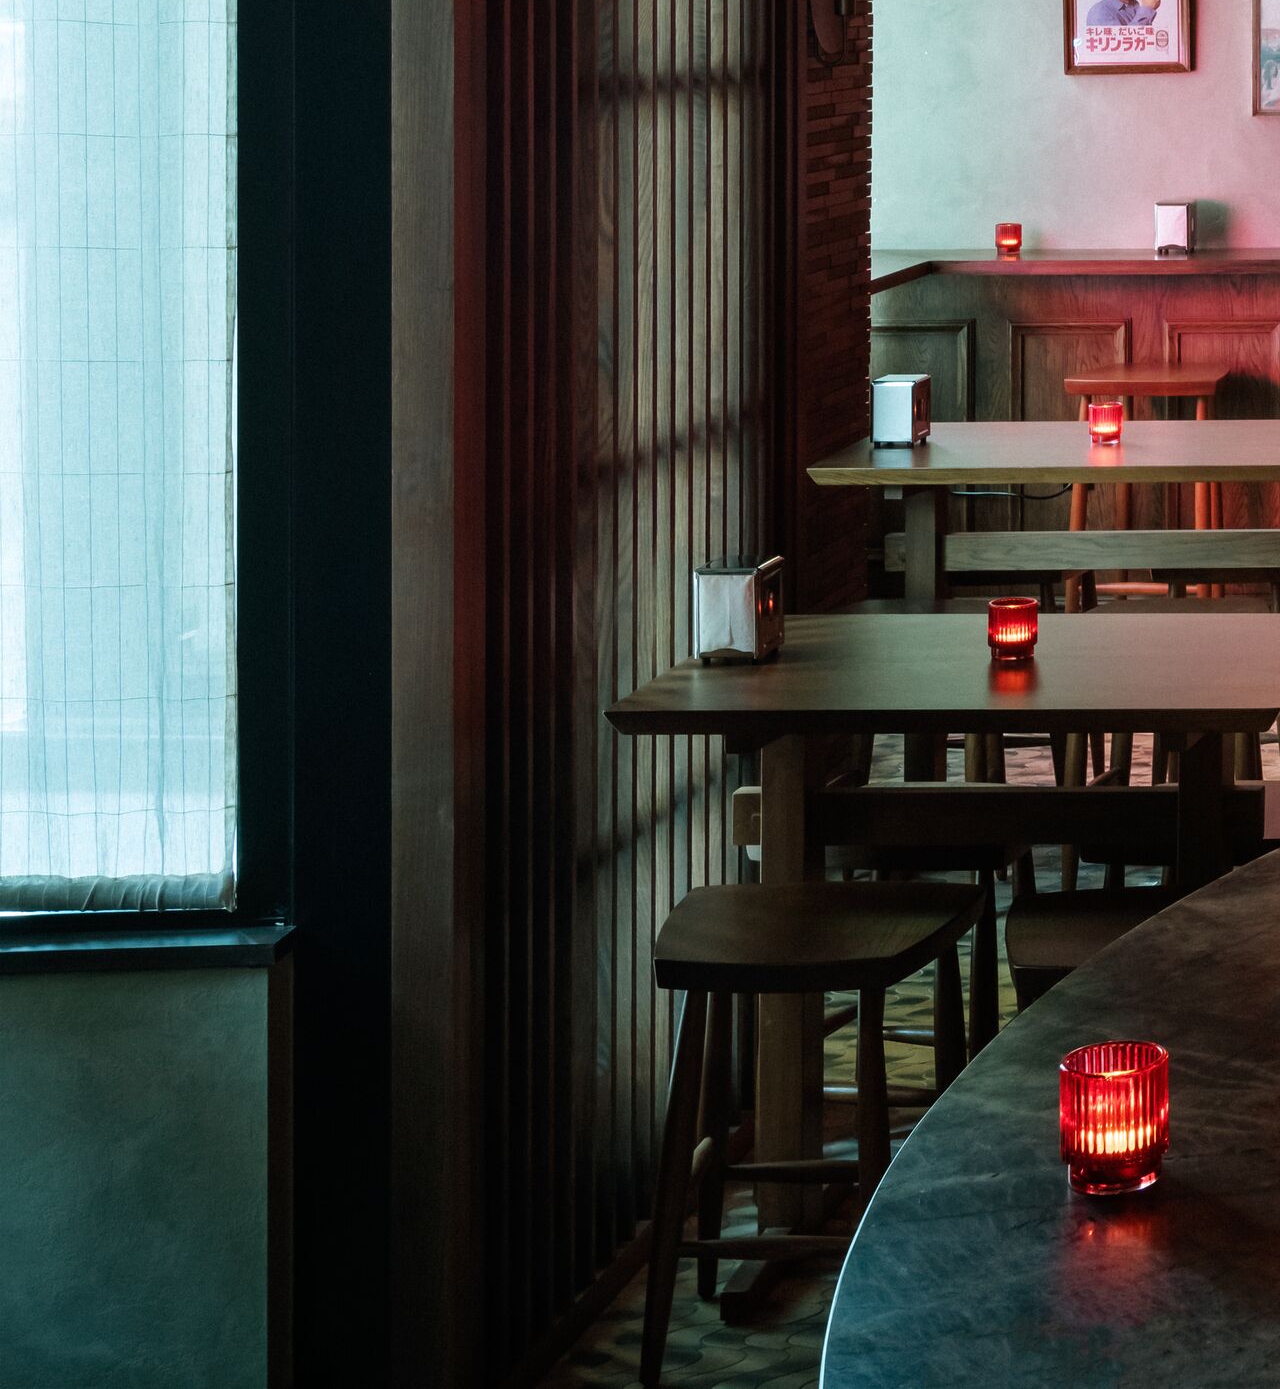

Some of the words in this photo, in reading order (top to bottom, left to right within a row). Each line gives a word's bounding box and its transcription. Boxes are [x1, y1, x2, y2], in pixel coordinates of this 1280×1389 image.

[1086, 27, 1155, 37] キレ味、だいご味
[1086, 37, 1155, 52] キリンラガー
